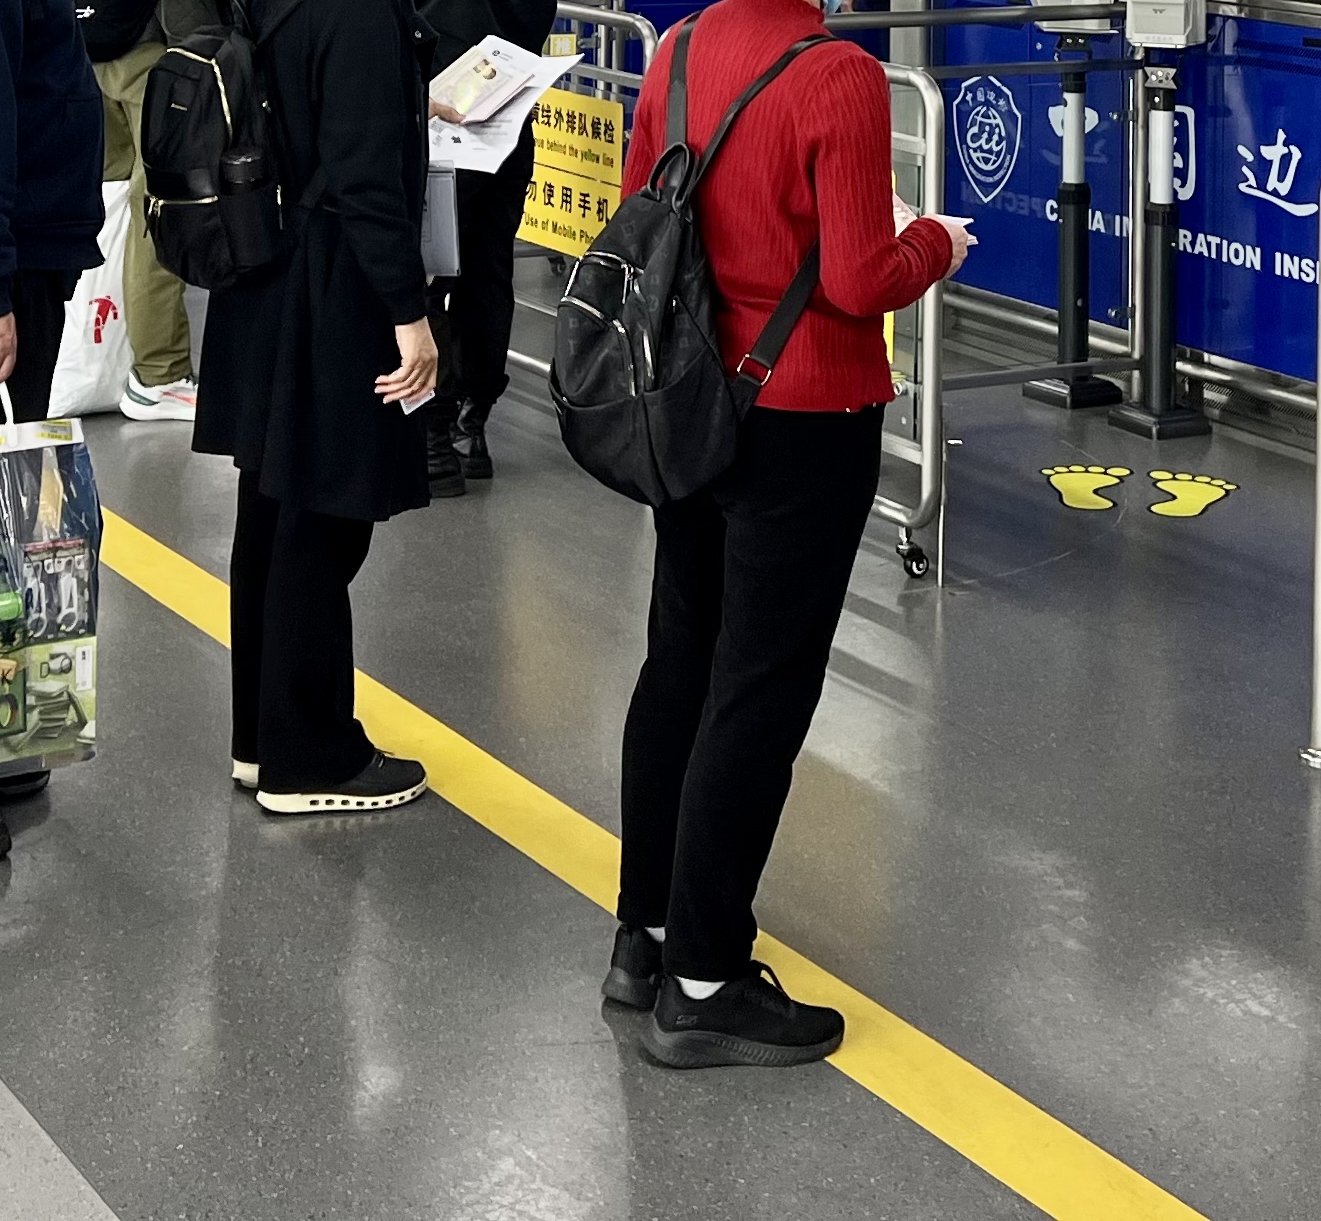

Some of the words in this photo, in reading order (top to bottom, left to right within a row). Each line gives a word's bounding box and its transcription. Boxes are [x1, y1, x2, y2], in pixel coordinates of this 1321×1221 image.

[568, 143, 579, 159] the
[525, 212, 538, 228] Use
[541, 218, 549, 232] of
[552, 221, 576, 241] Mobile
